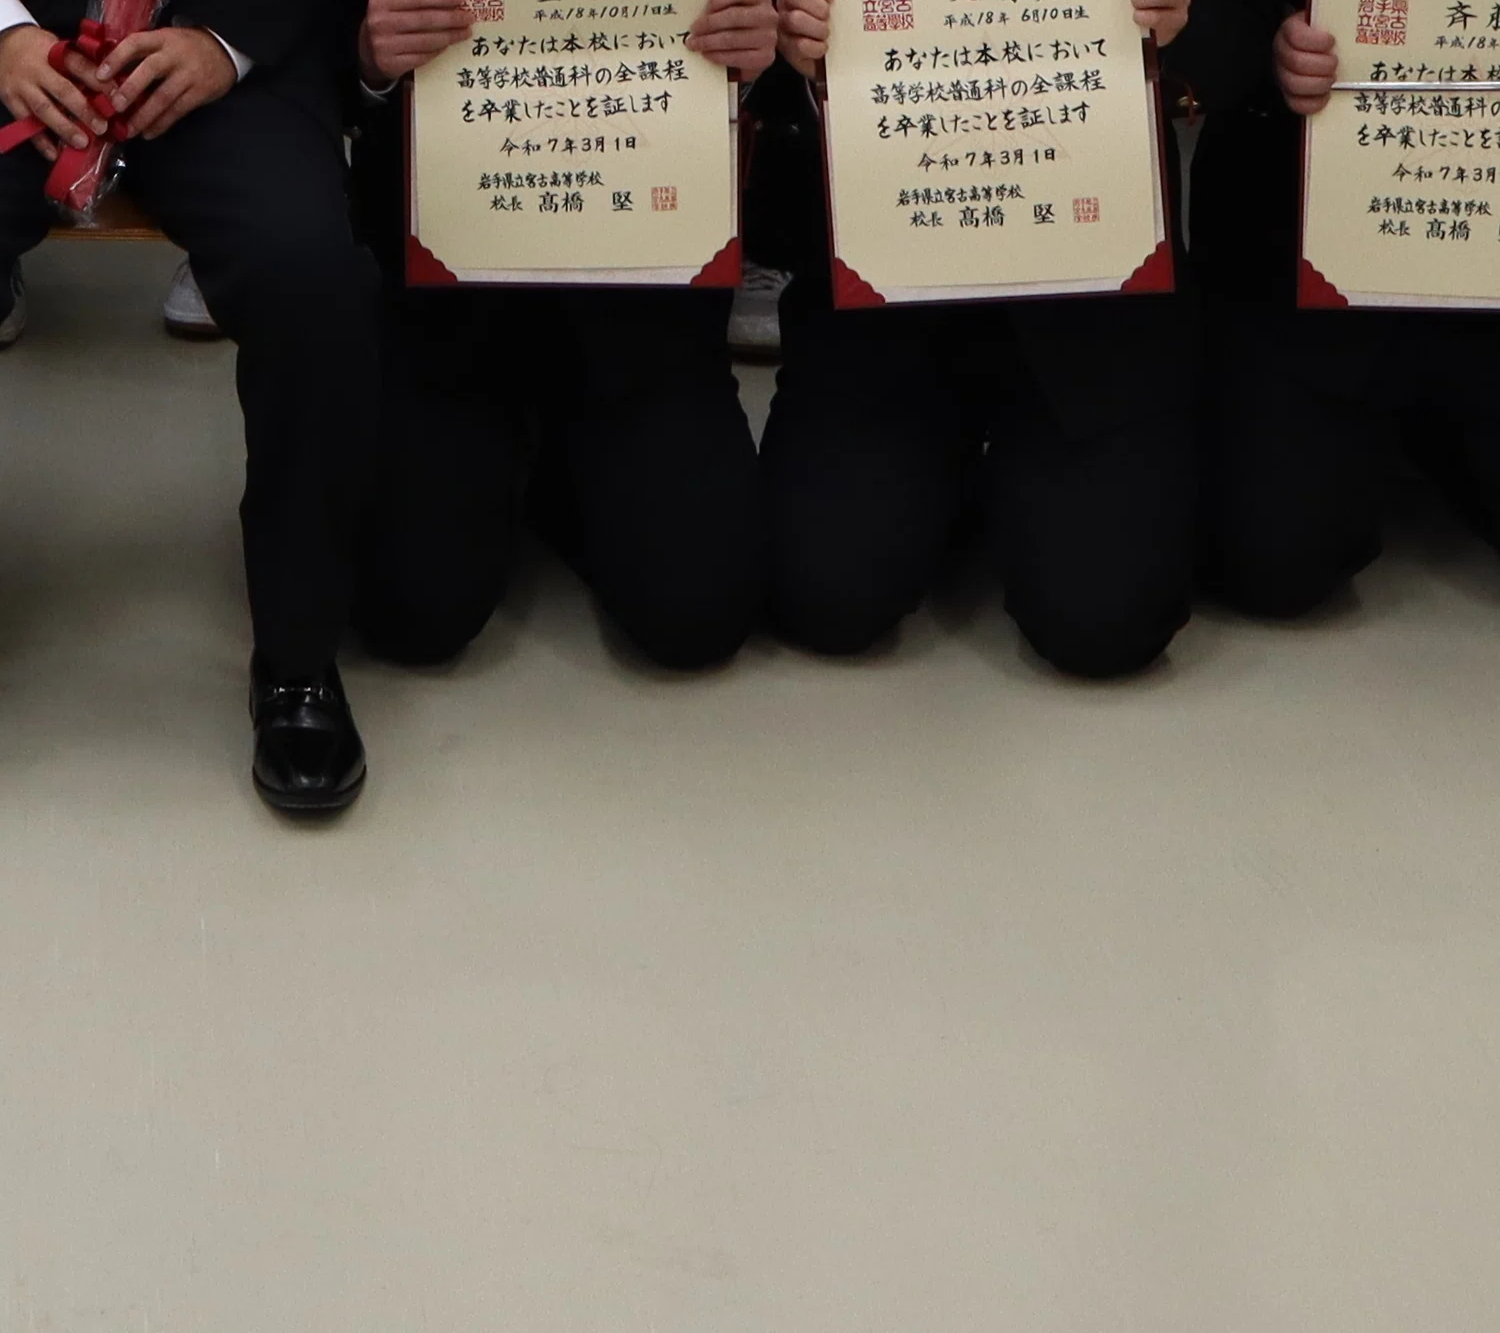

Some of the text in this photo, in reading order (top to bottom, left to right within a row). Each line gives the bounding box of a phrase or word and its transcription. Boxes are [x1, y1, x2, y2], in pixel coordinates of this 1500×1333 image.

[472, 31, 691, 55] あなたは本校において
[884, 38, 1107, 71] あなたは本校において
[462, 91, 672, 123] を卒業したことを証します
[877, 101, 1091, 139] を卒業したことを証します
[500, 137, 637, 155] 令和7年3月1日
[918, 147, 1056, 170] 令和7年3月1日
